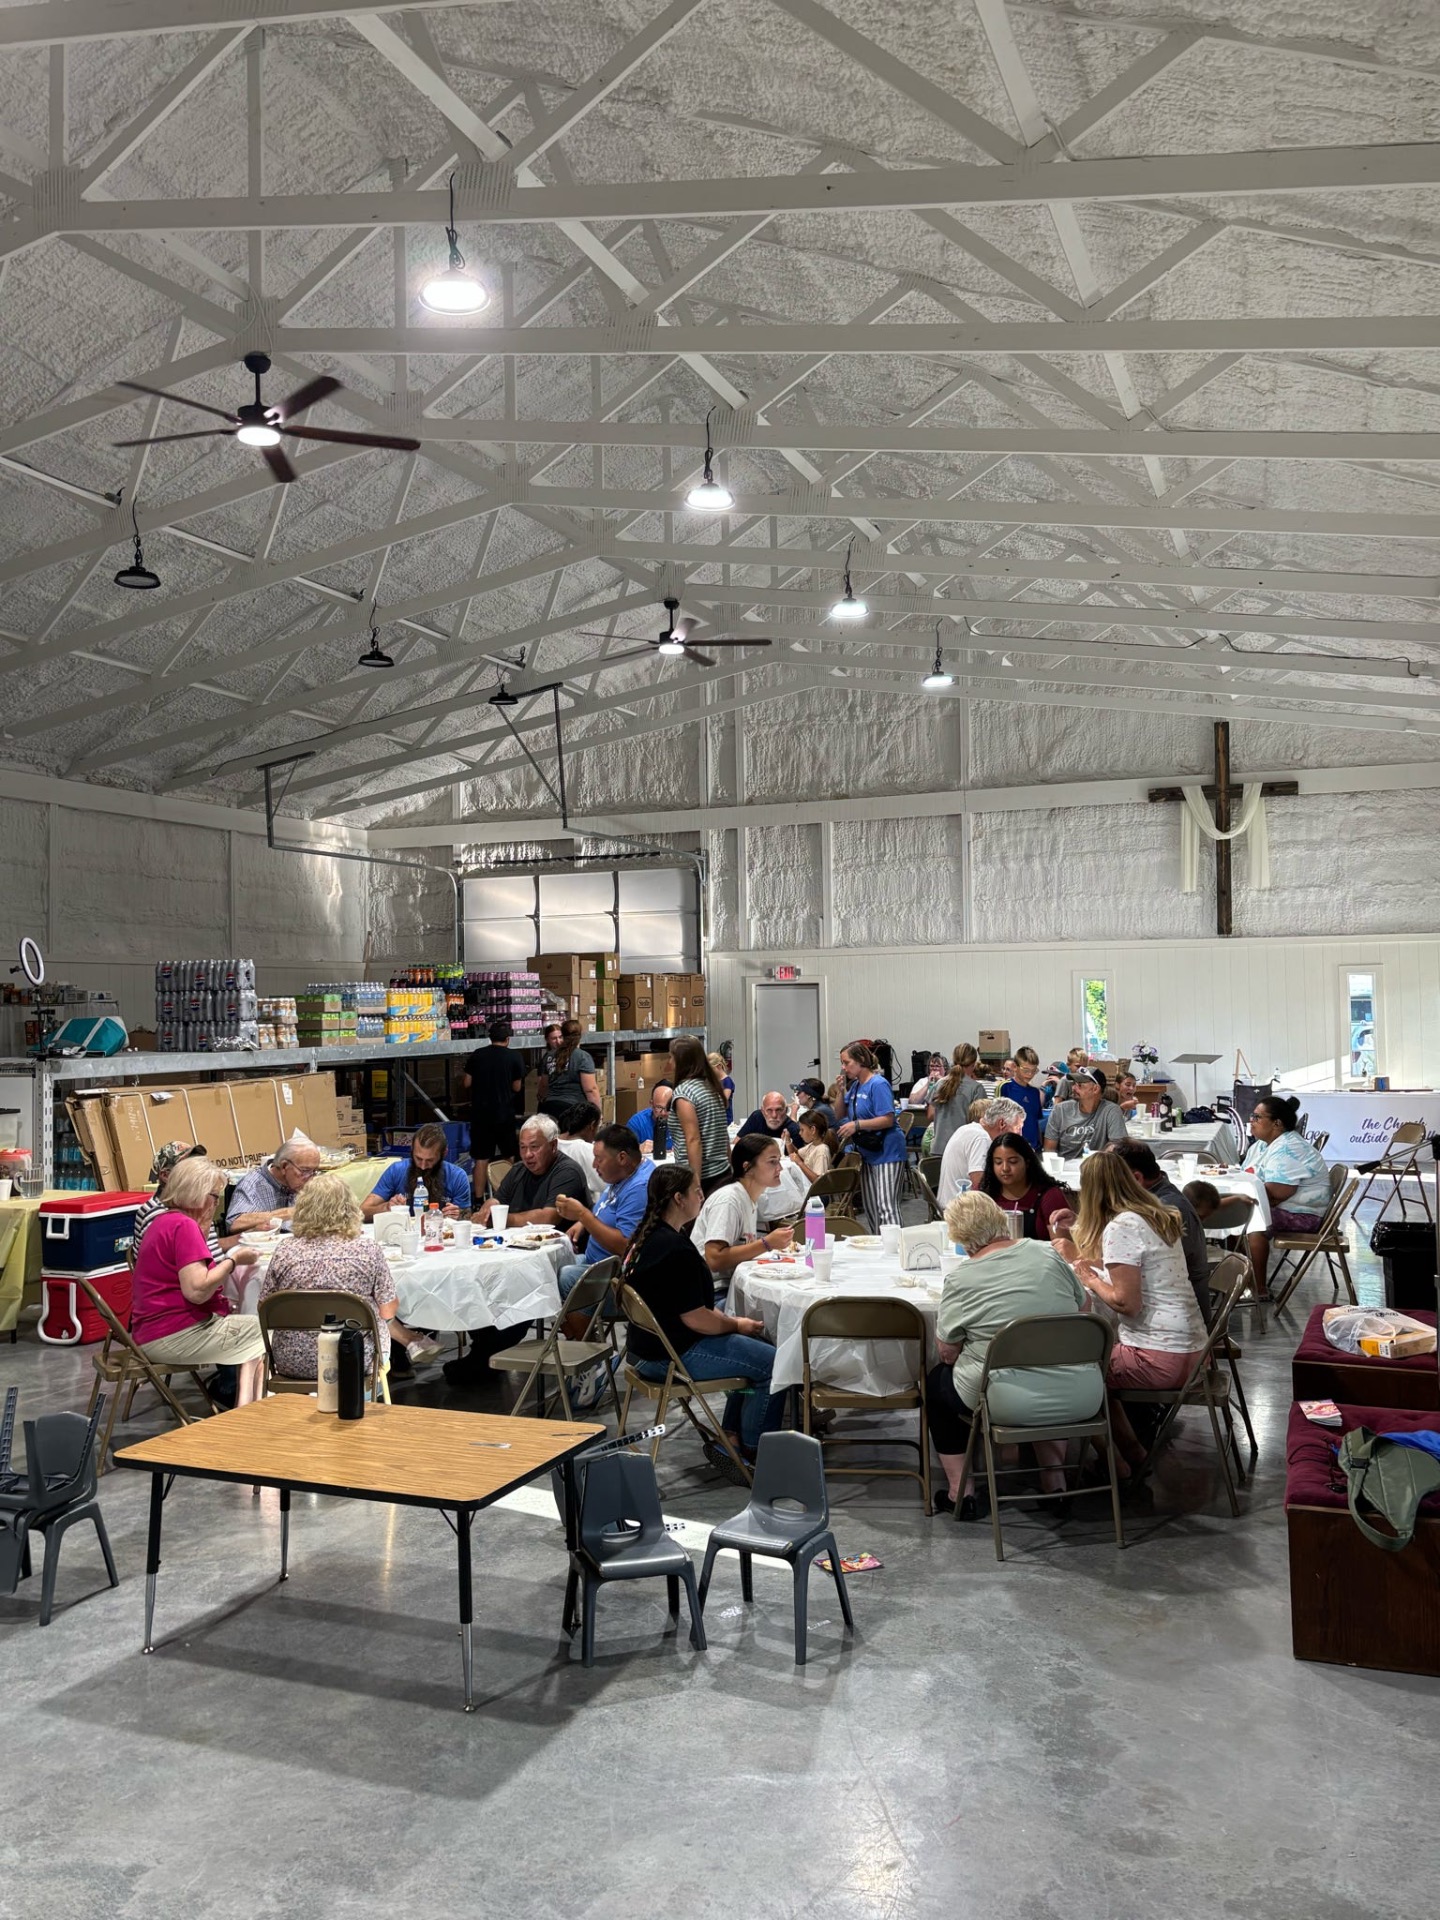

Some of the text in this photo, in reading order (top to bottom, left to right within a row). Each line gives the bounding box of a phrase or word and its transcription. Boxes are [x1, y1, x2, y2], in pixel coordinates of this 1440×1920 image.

[779, 966, 794, 978] EXIT
[1361, 1118, 1381, 1130] the
[1349, 1131, 1389, 1144] outside
[216, 1158, 227, 1167] DO
[228, 1155, 242, 1166] NOT
